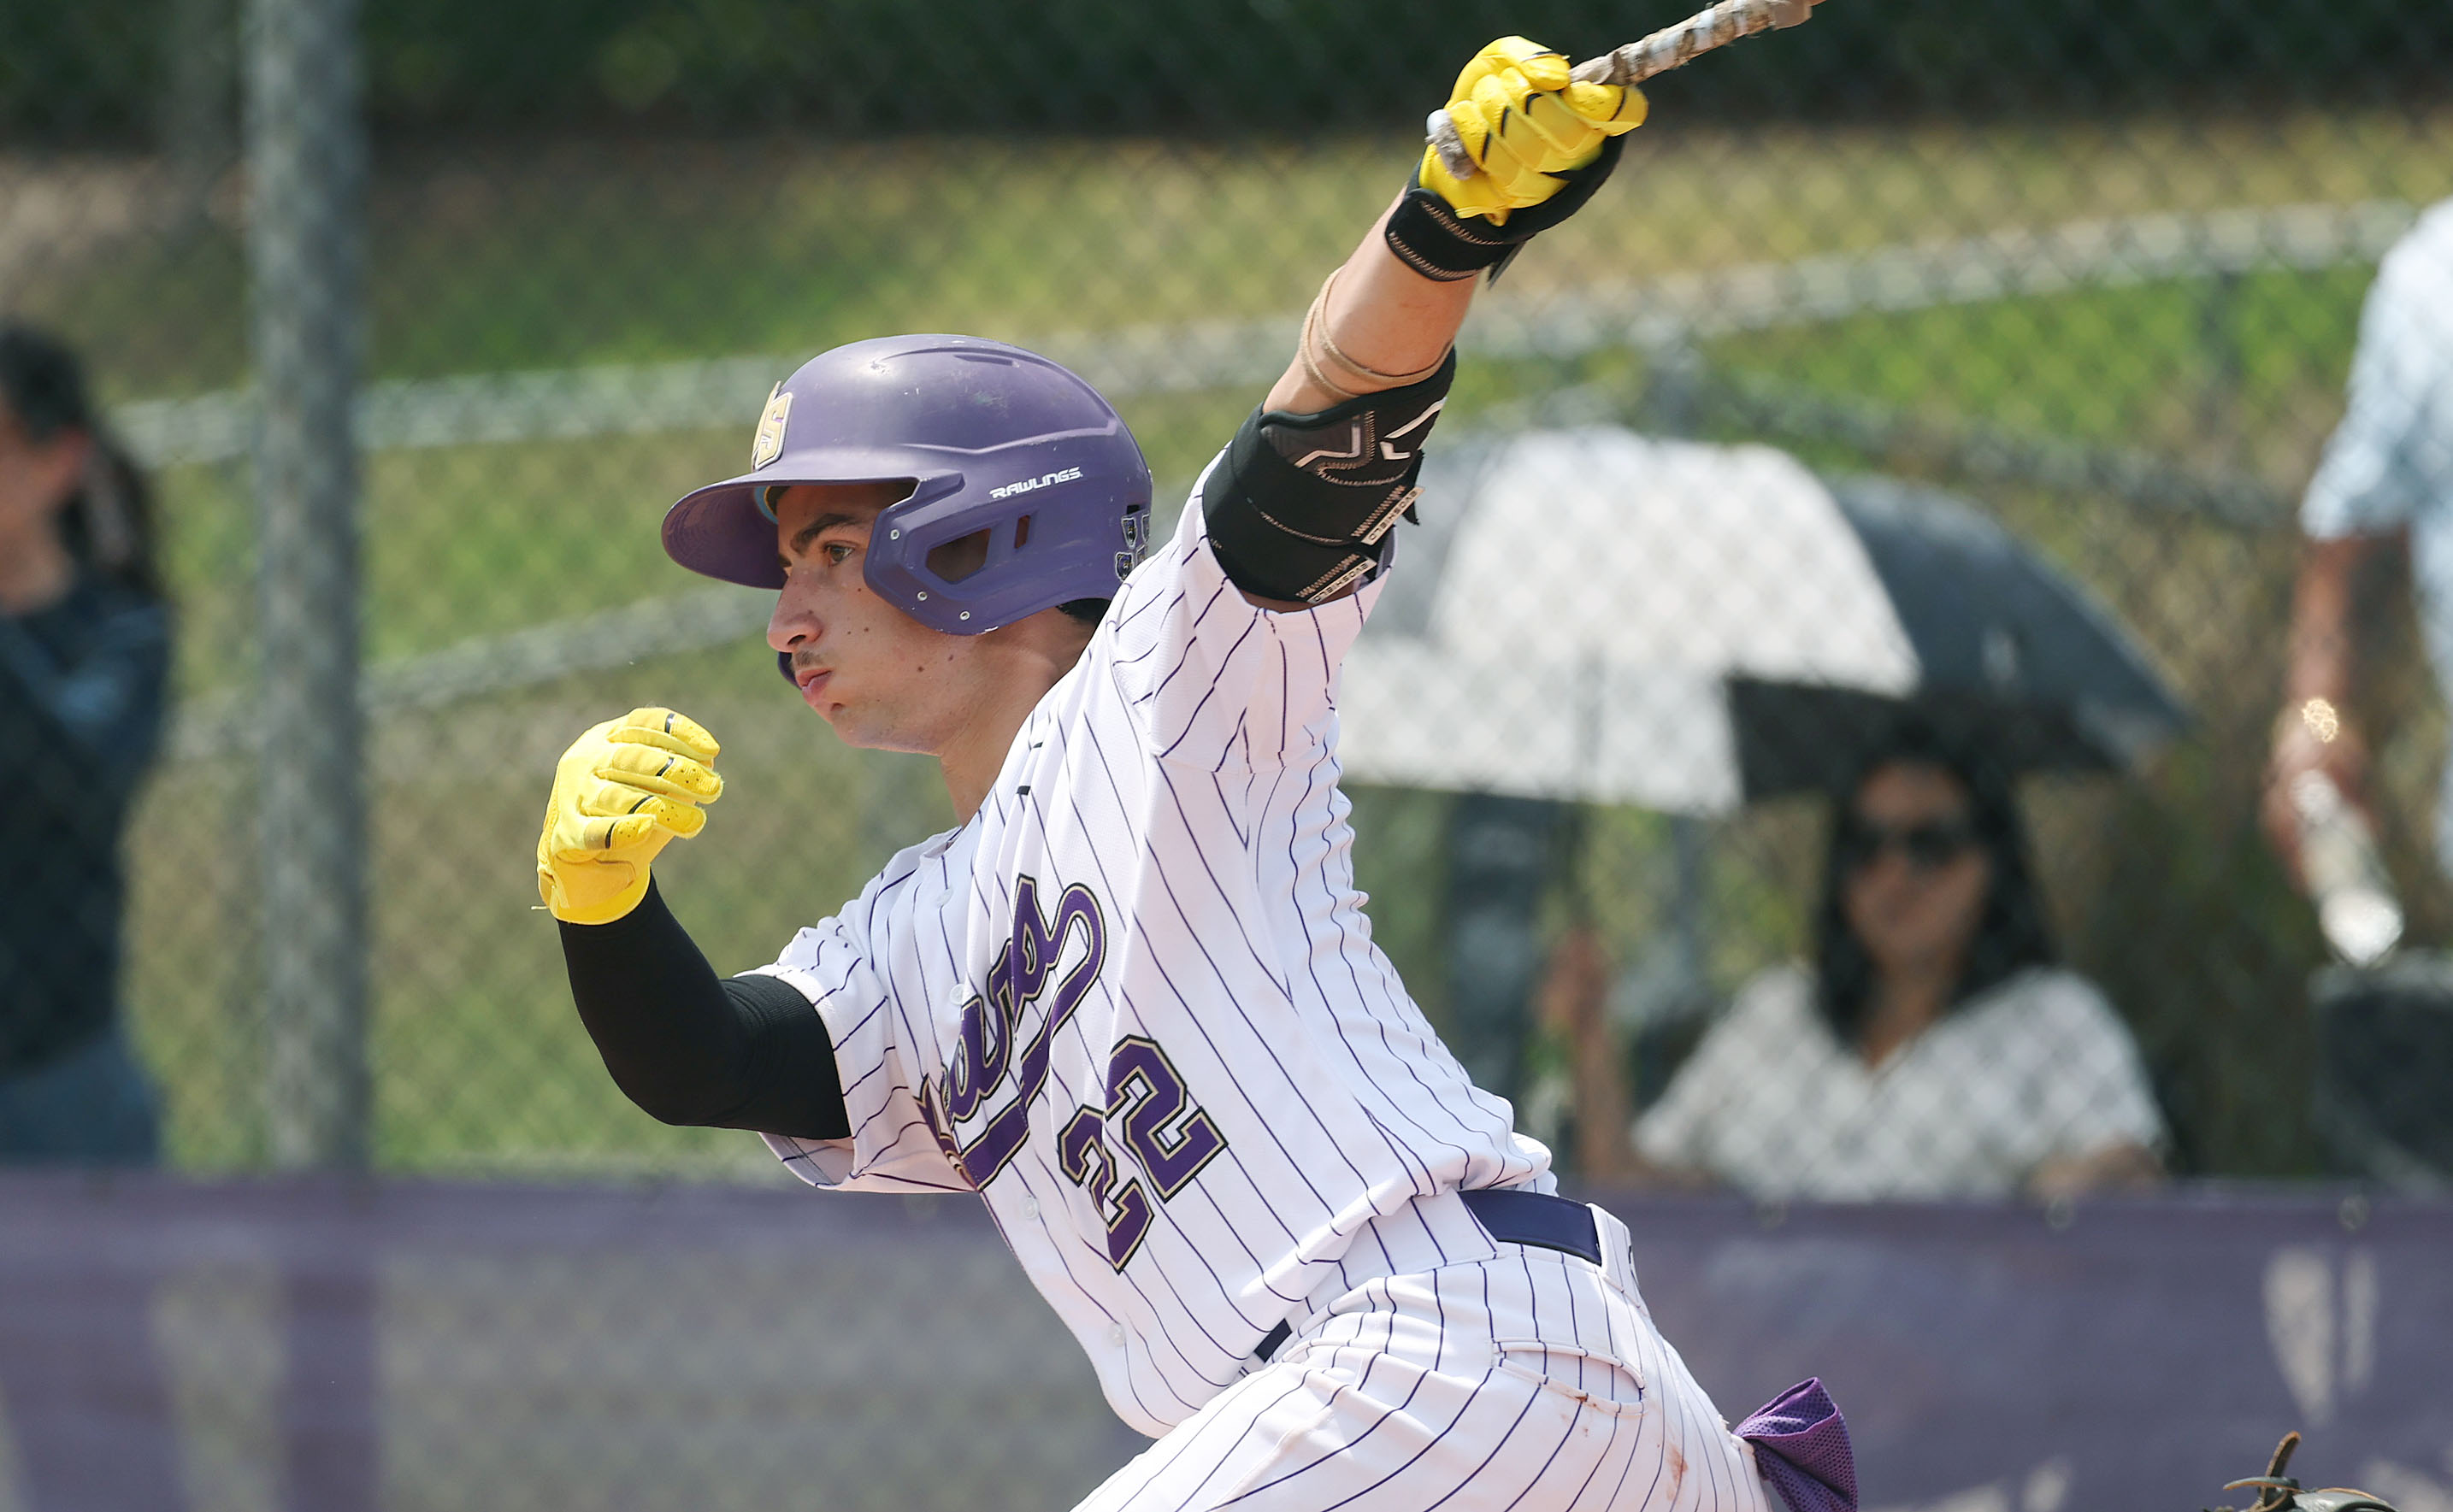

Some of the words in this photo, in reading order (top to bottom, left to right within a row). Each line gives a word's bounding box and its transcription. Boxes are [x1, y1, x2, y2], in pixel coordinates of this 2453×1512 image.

[988, 466, 1082, 499] RAWLINGS
[1368, 490, 1418, 541] EVOSHIELD
[1313, 562, 1369, 602] EVOSHIELD
[1057, 1033, 1229, 1274] 22
